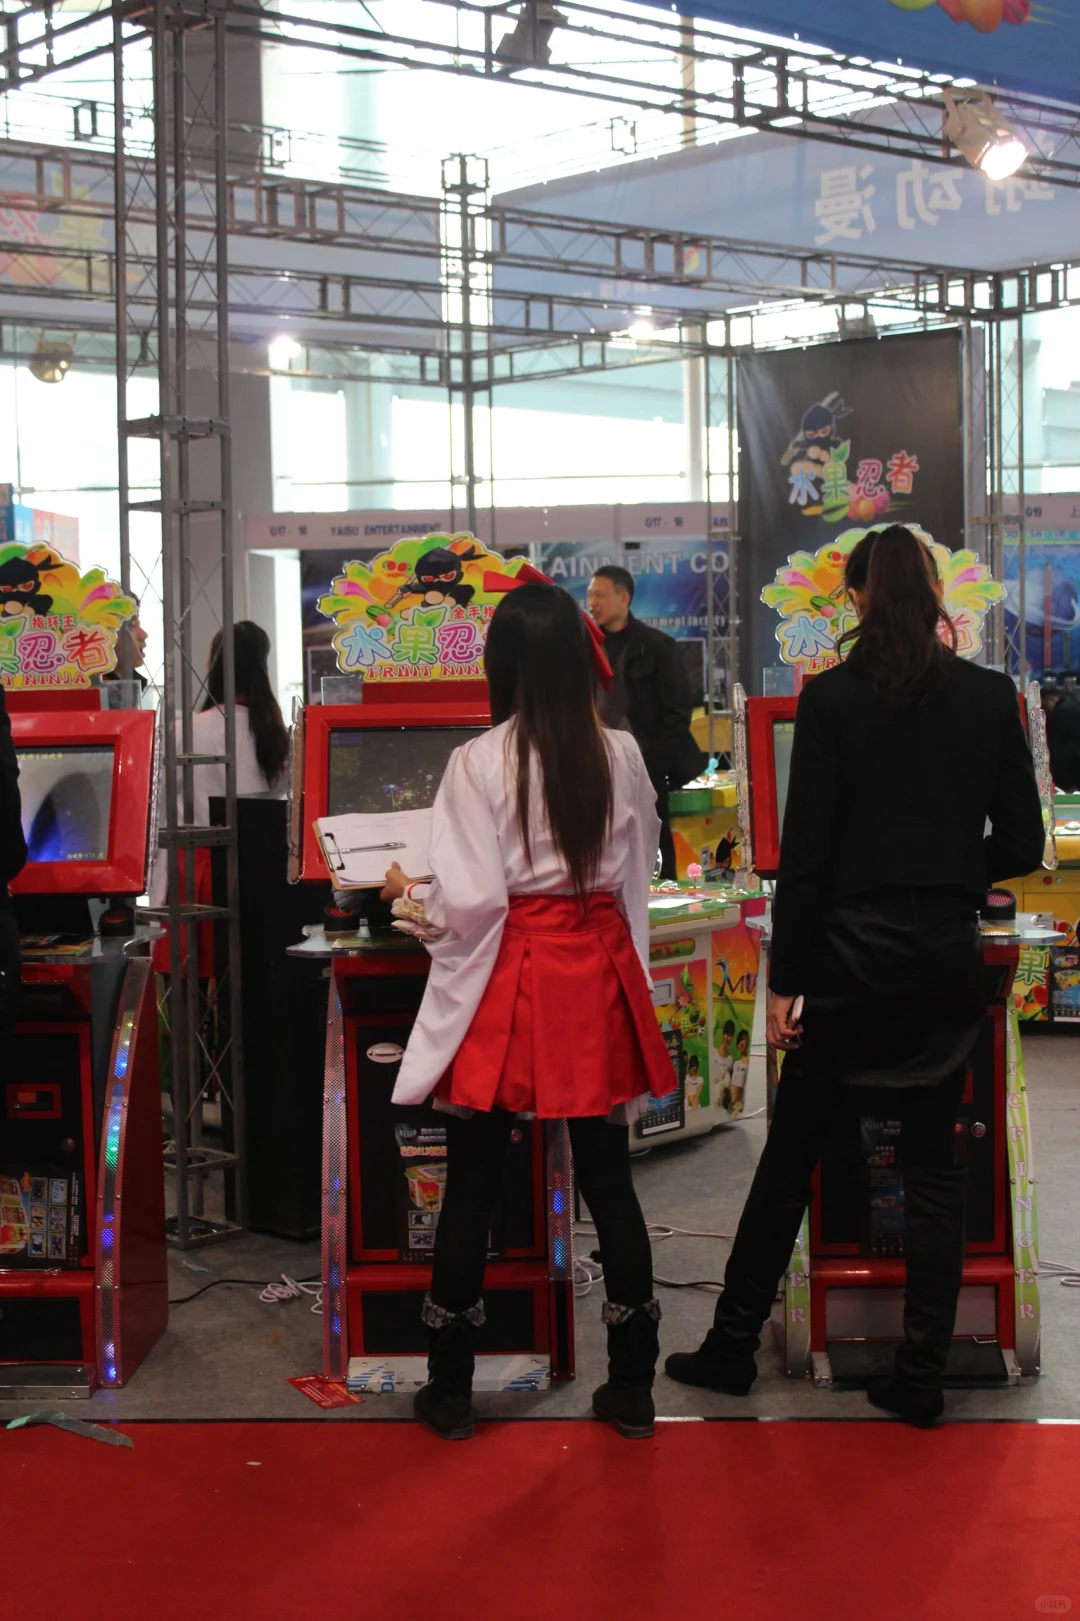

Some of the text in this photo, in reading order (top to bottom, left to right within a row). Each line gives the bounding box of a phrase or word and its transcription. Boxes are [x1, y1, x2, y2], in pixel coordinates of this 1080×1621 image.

[788, 449, 920, 506] 水果忍者
[713, 517, 729, 528] AIS
[452, 605, 496, 619] 金手指
[31, 615, 75, 629] 指环王
[688, 615, 726, 628] factry
[341, 621, 485, 667] 水果忍
[809, 657, 846, 671] FR
[367, 664, 433, 679] FRUIT
[24, 673, 88, 686] NINJA
[719, 973, 757, 997] MU
